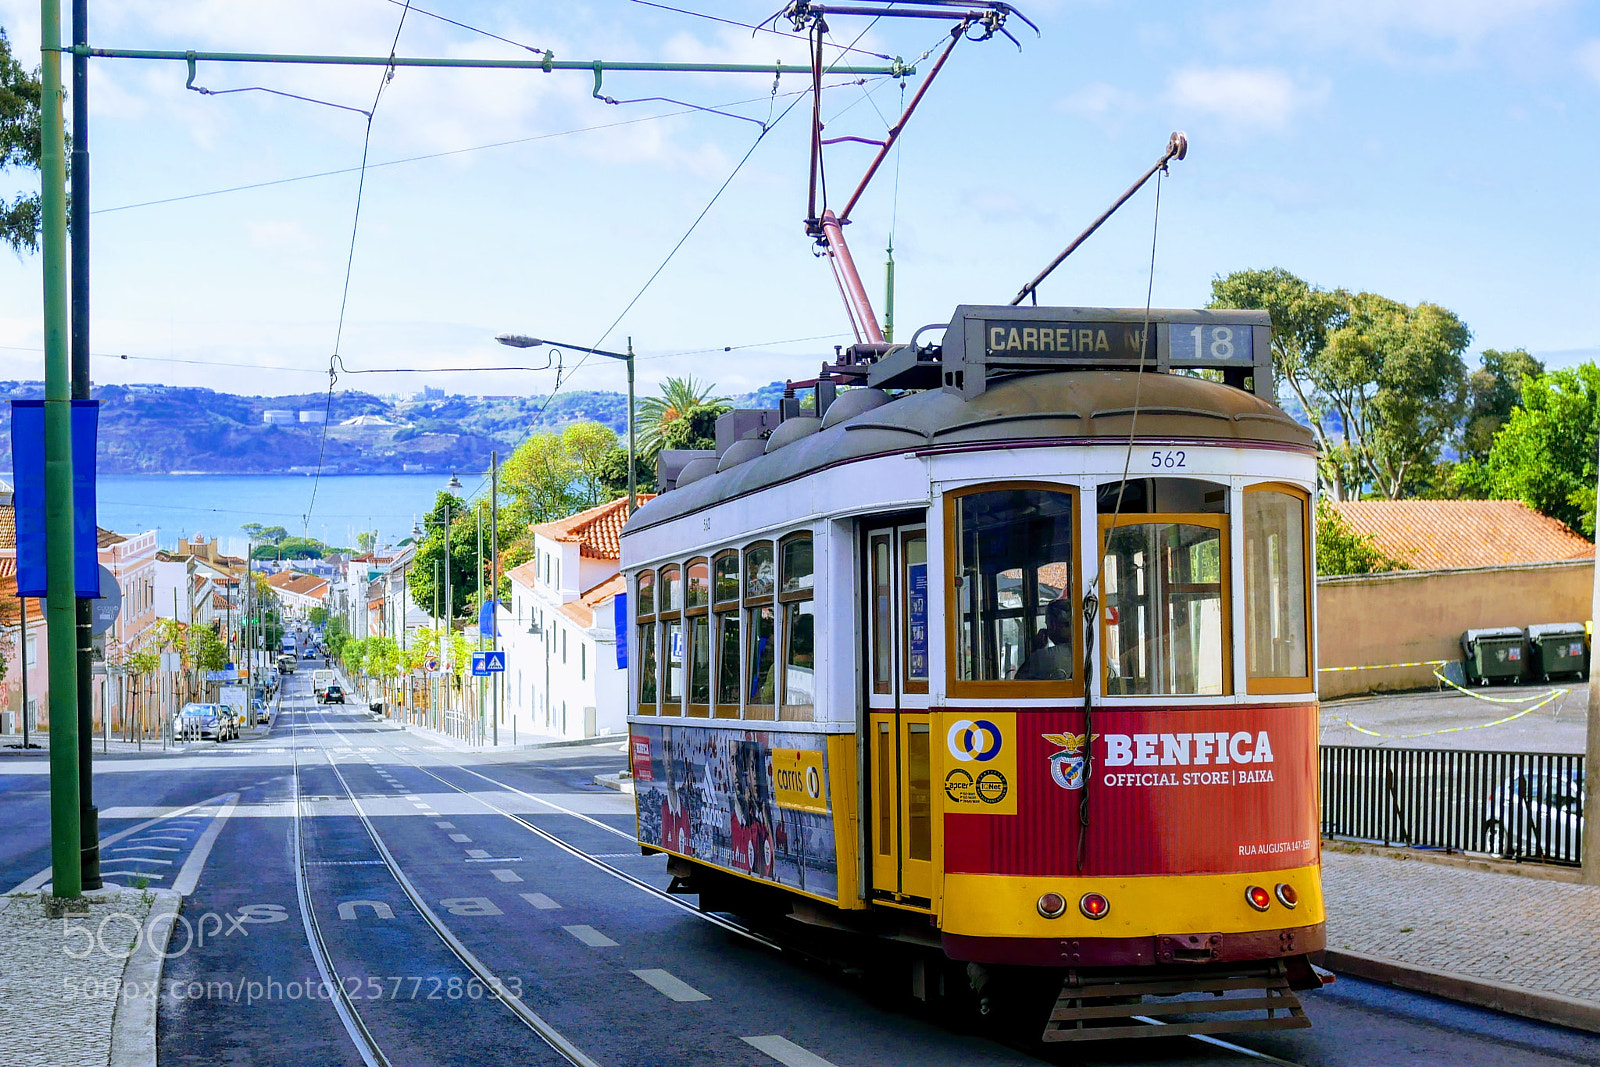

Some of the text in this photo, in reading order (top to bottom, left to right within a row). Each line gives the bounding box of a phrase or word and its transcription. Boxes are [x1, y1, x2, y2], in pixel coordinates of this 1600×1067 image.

[990, 327, 1110, 352] CARREIRA
[1189, 325, 1234, 360] 18
[1151, 451, 1186, 468] 562
[1104, 731, 1274, 767] BENFICA
[1103, 770, 1274, 787] OFFICIAL STORE BAIXA
[1238, 845, 1257, 856] RUA
[1257, 842, 1292, 855] AUGUSTA
